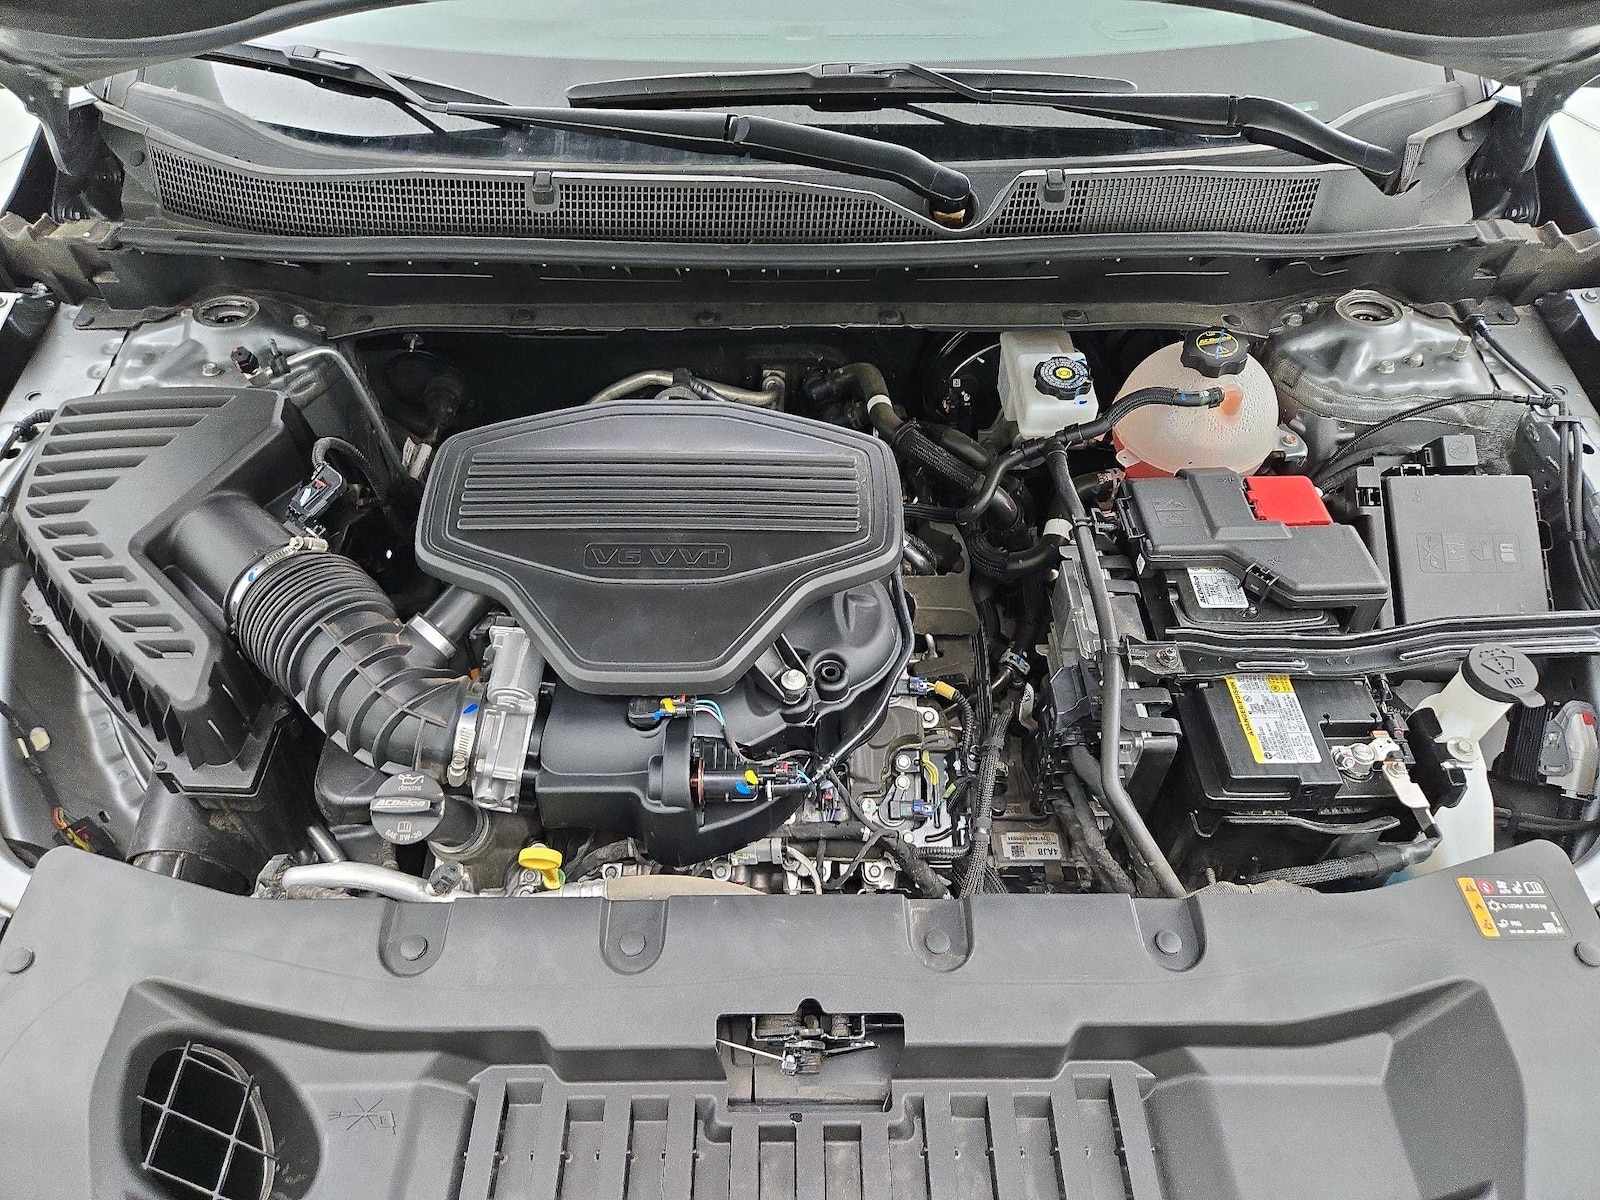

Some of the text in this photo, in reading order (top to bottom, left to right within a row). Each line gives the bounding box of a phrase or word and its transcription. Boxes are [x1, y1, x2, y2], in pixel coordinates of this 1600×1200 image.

[591, 548, 725, 564] V6 VVT
[373, 799, 426, 808] ACDelco
[385, 829, 398, 839] SAE
